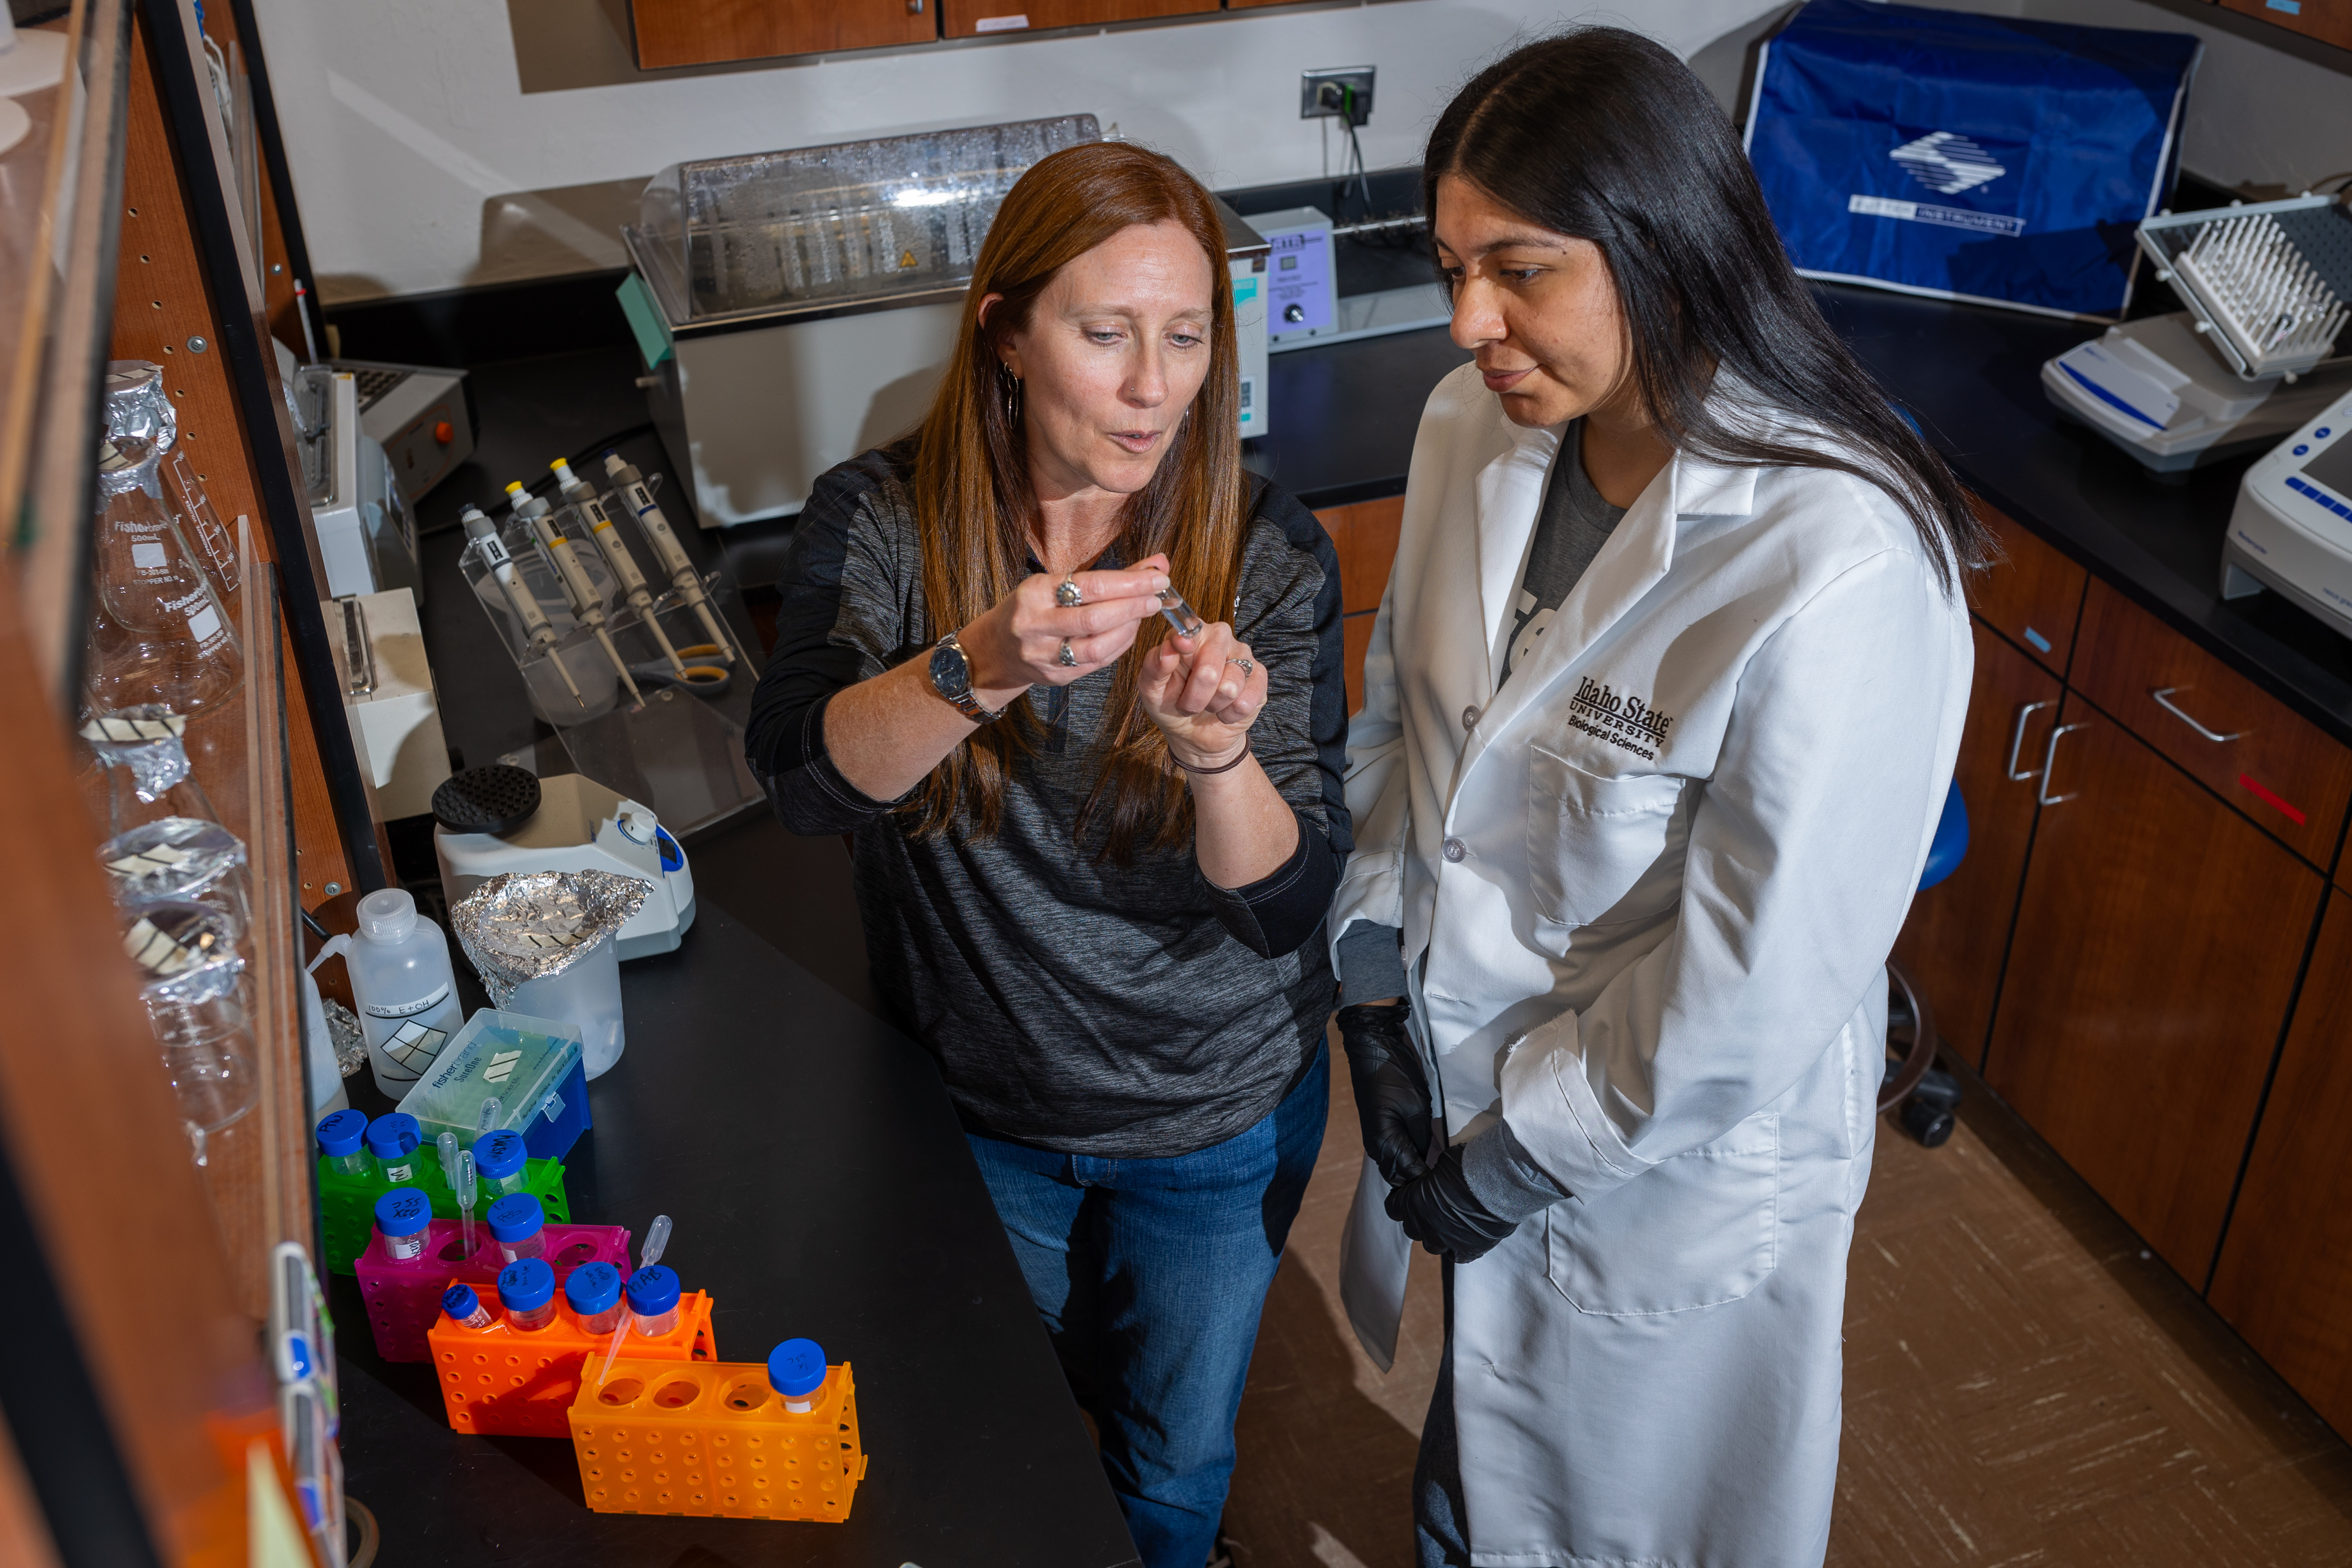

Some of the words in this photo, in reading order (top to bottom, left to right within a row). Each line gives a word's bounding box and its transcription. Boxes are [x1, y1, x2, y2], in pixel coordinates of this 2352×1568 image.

[130, 533, 161, 542] 500mL
[1575, 675, 1621, 712] Idaho
[1622, 696, 1669, 734] State
[1569, 701, 1664, 748] UNIVERSITY
[1568, 715, 1611, 741] Biological
[1610, 732, 1654, 760] Sciences
[368, 1005, 391, 1014] 100%
[432, 1040, 477, 1088] fisherbrand
[454, 1057, 482, 1082] SureOne
[391, 1197, 421, 1208] SSC
[497, 1209, 522, 1222] PBS
